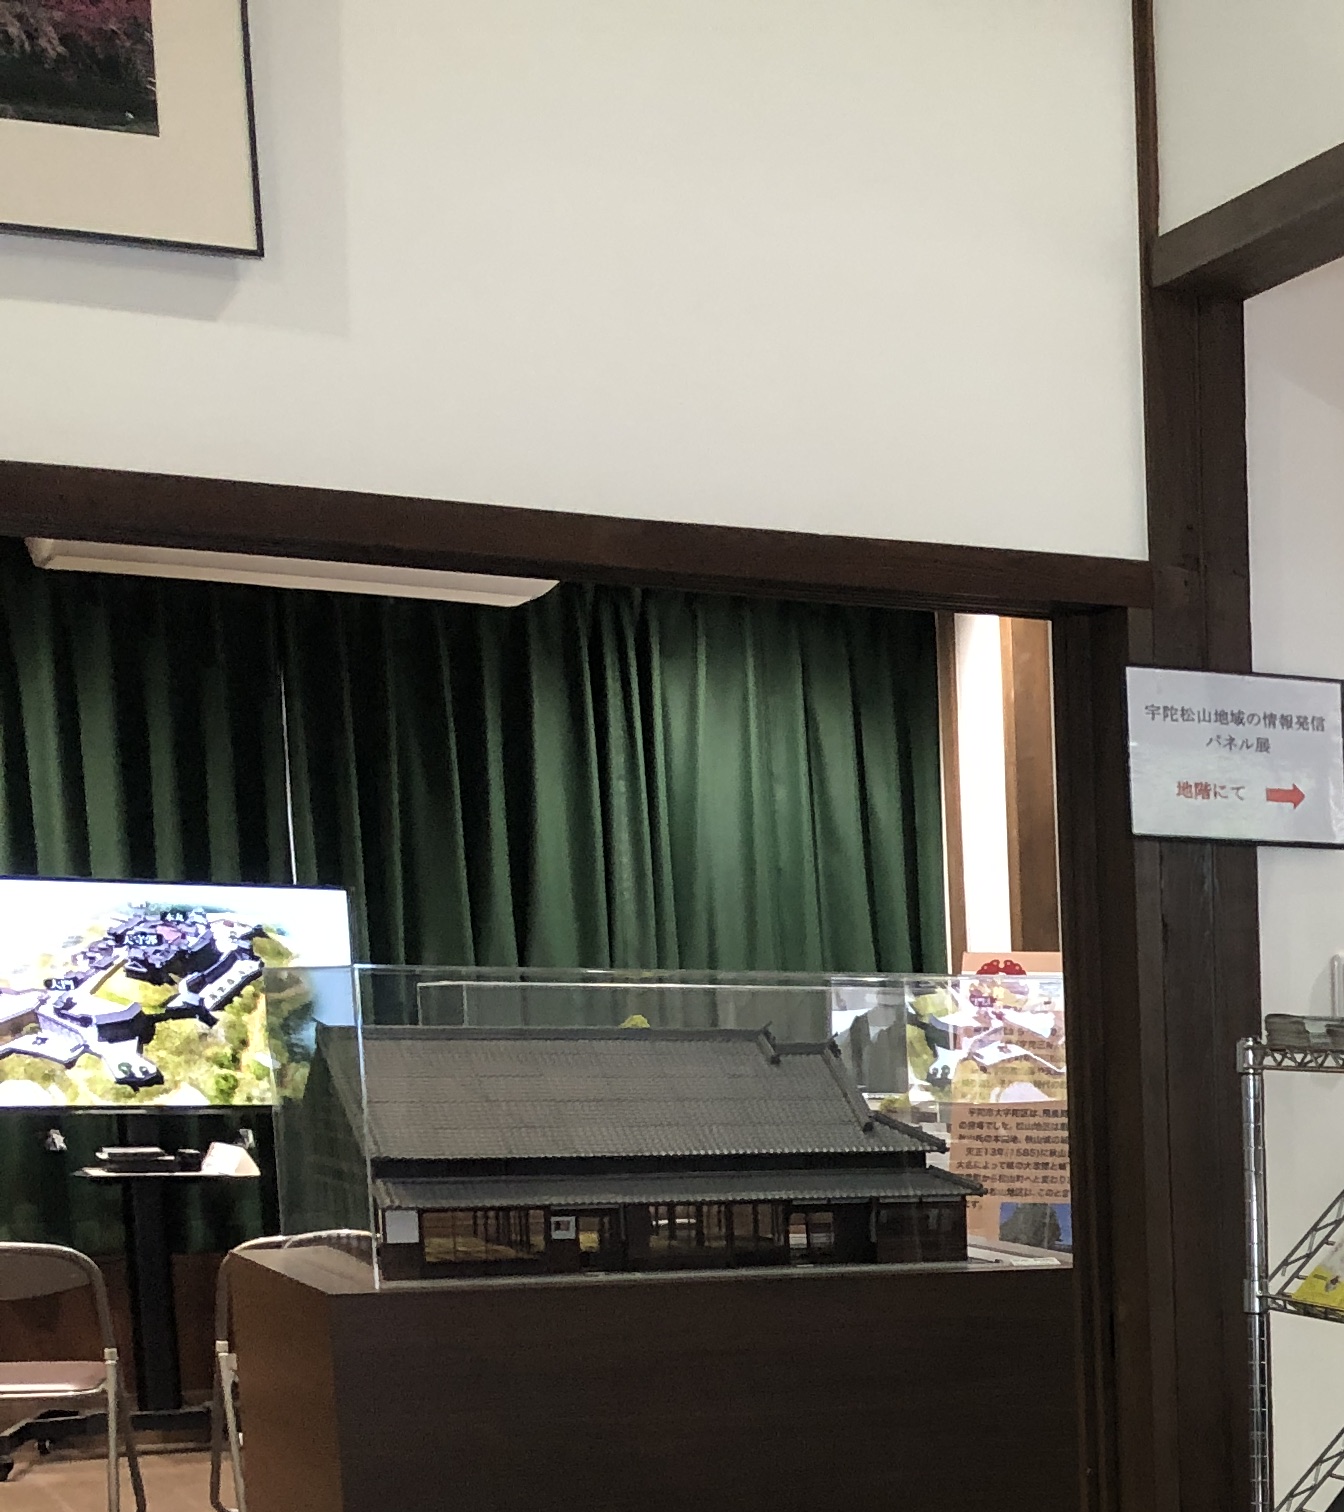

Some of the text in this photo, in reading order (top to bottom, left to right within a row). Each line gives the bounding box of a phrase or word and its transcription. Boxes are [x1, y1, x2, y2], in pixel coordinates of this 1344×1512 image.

[1144, 704, 1326, 732] 宇陀松山地域の情報発信
[1205, 734, 1271, 754] パネル展
[1175, 781, 1246, 802] 地階にて
